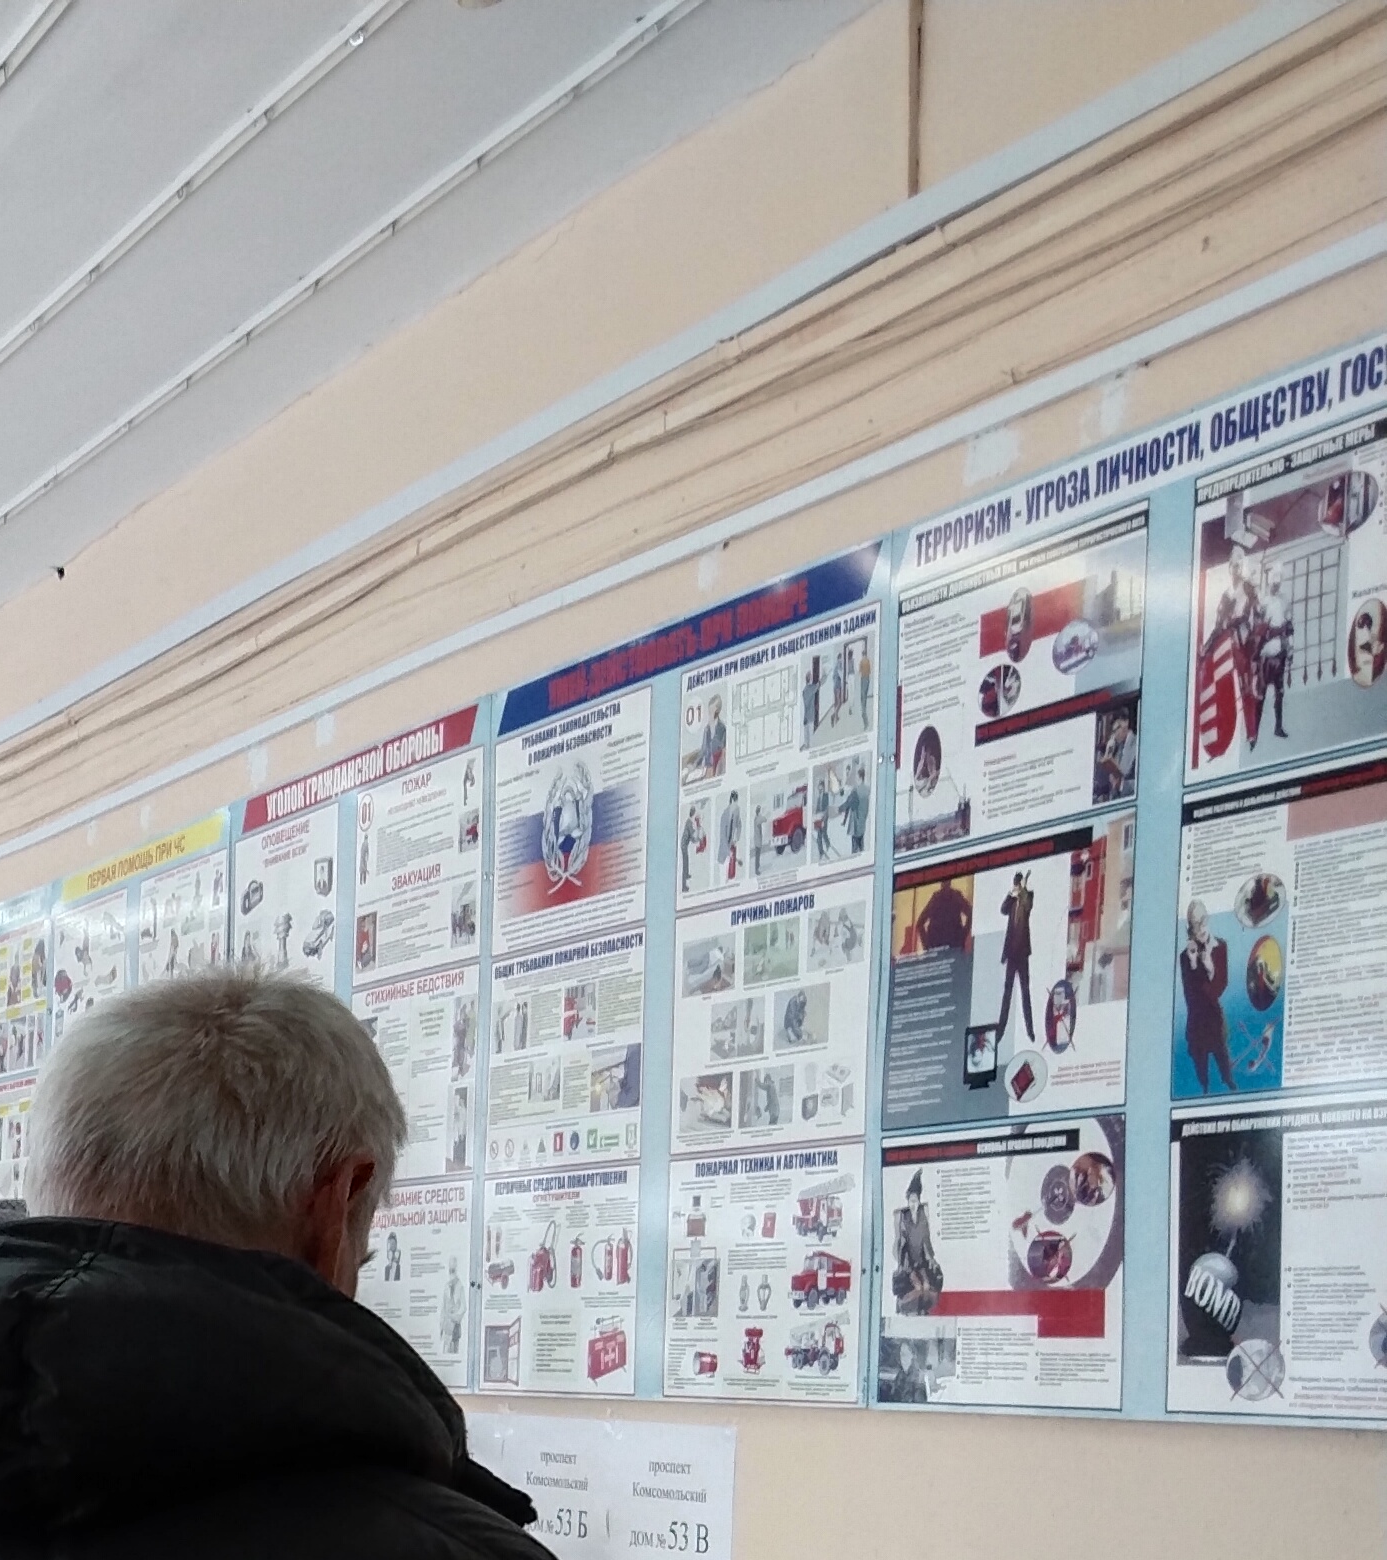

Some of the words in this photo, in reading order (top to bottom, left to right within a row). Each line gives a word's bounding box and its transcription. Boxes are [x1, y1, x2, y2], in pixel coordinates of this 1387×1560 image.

[916, 497, 1013, 568] ТЕРРОРИЗМ
[1026, 470, 1090, 525] УГРОЗА
[1094, 421, 1204, 498] ЛИЧНОСТИ,
[1209, 367, 1333, 453] ОБЩЕСТВУ,
[1338, 344, 1387, 403] ГОС
[686, 663, 723, 692] ДЕЙСТВИЯ
[724, 658, 738, 677] ПРИ
[739, 649, 769, 671] ПОЖАРЕ
[777, 623, 842, 658] ОБЩЕСТВЕННОМ
[843, 608, 877, 634] ЗДАНИИ
[685, 704, 702, 727] 01
[266, 791, 306, 822] УГОЛОК
[306, 744, 384, 806] ГРАЖДАНСКОЙ
[385, 722, 444, 773] ОБОРОНЫ
[401, 772, 433, 796] ПОЖАР
[261, 818, 310, 851] ОПОВЕЩЕНИЕ
[87, 864, 116, 892] ПЕРВАЯ
[117, 849, 154, 878] ПОМОЩЬ
[155, 839, 172, 863] ПРИ
[391, 862, 441, 892] ЭВАКУАЦИЯ
[730, 904, 773, 927] ПРИЧИНЫ
[774, 893, 815, 917] ПОЖАРОВ
[365, 981, 415, 1007] СТИХИЙНЫЕ
[416, 970, 465, 995] БЕДСТВИЯ
[695, 1160, 739, 1178] ПОЖАРНАЯ
[740, 1155, 775, 1174] ТЕХНИКА
[776, 1154, 782, 1171] И
[783, 1150, 838, 1170] АВТОМАТИКА
[424, 1186, 466, 1204] СРЕДСТВ
[427, 1207, 468, 1226] ЗАЩИТЫ
[540, 1450, 577, 1467] проспект
[648, 1460, 692, 1477] проспект
[526, 1471, 589, 1492] Комсомольский
[632, 1481, 707, 1504] Комсомольский
[577, 1510, 588, 1539] Б
[695, 1523, 709, 1554] В
